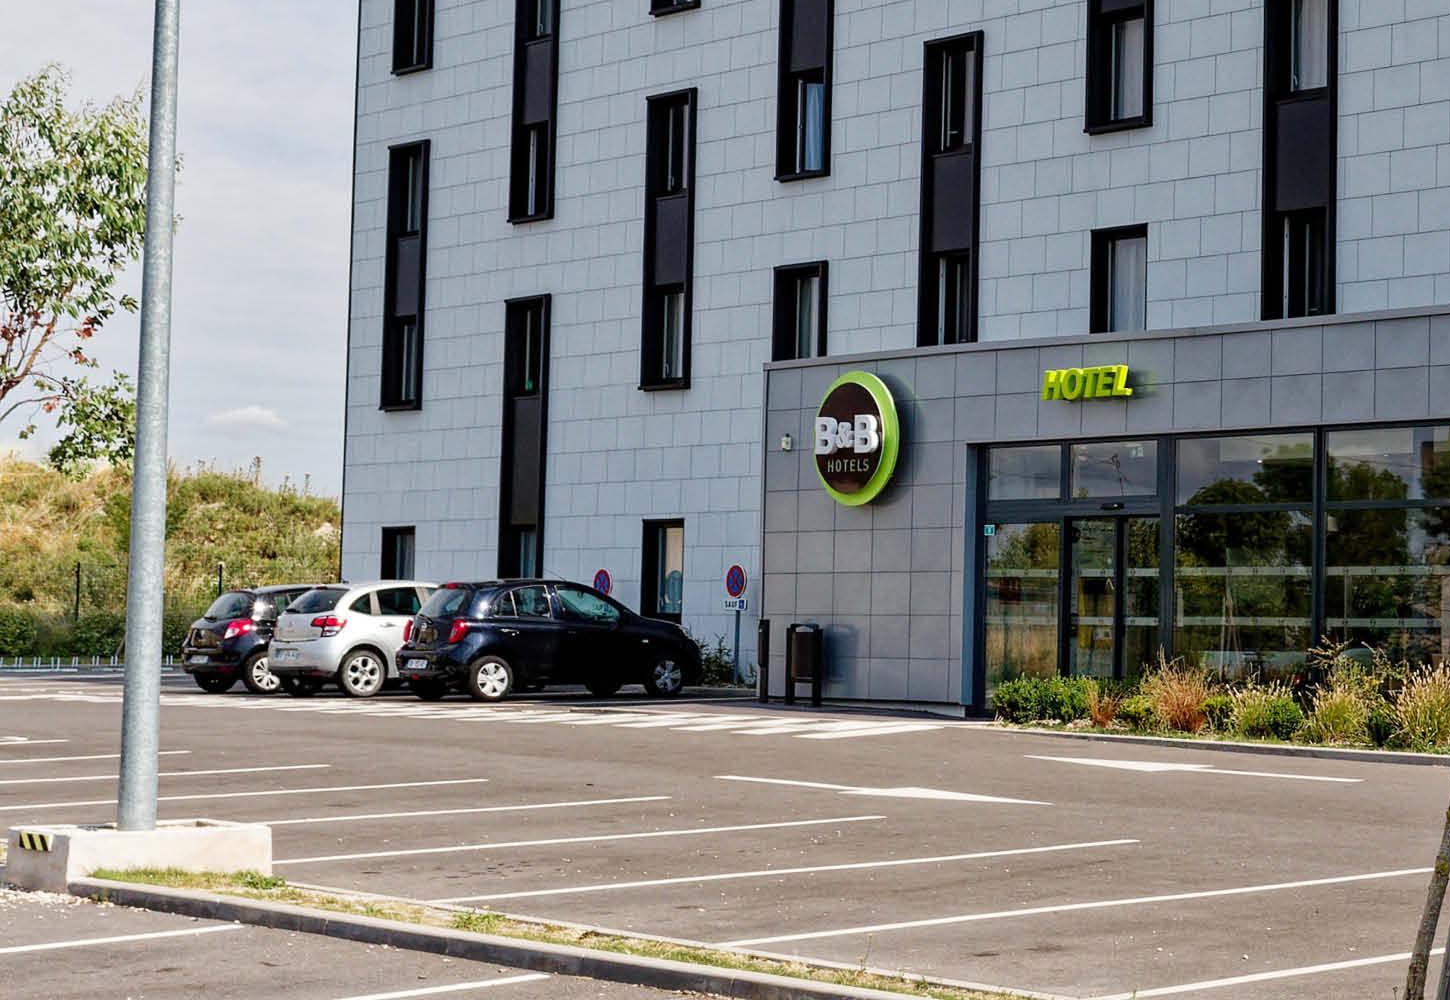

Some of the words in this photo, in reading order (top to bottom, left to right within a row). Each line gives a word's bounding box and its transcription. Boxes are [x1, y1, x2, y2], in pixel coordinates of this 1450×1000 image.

[1042, 364, 1134, 401] HOTEL
[815, 414, 879, 455] B&B
[827, 458, 870, 472] HOTELS
